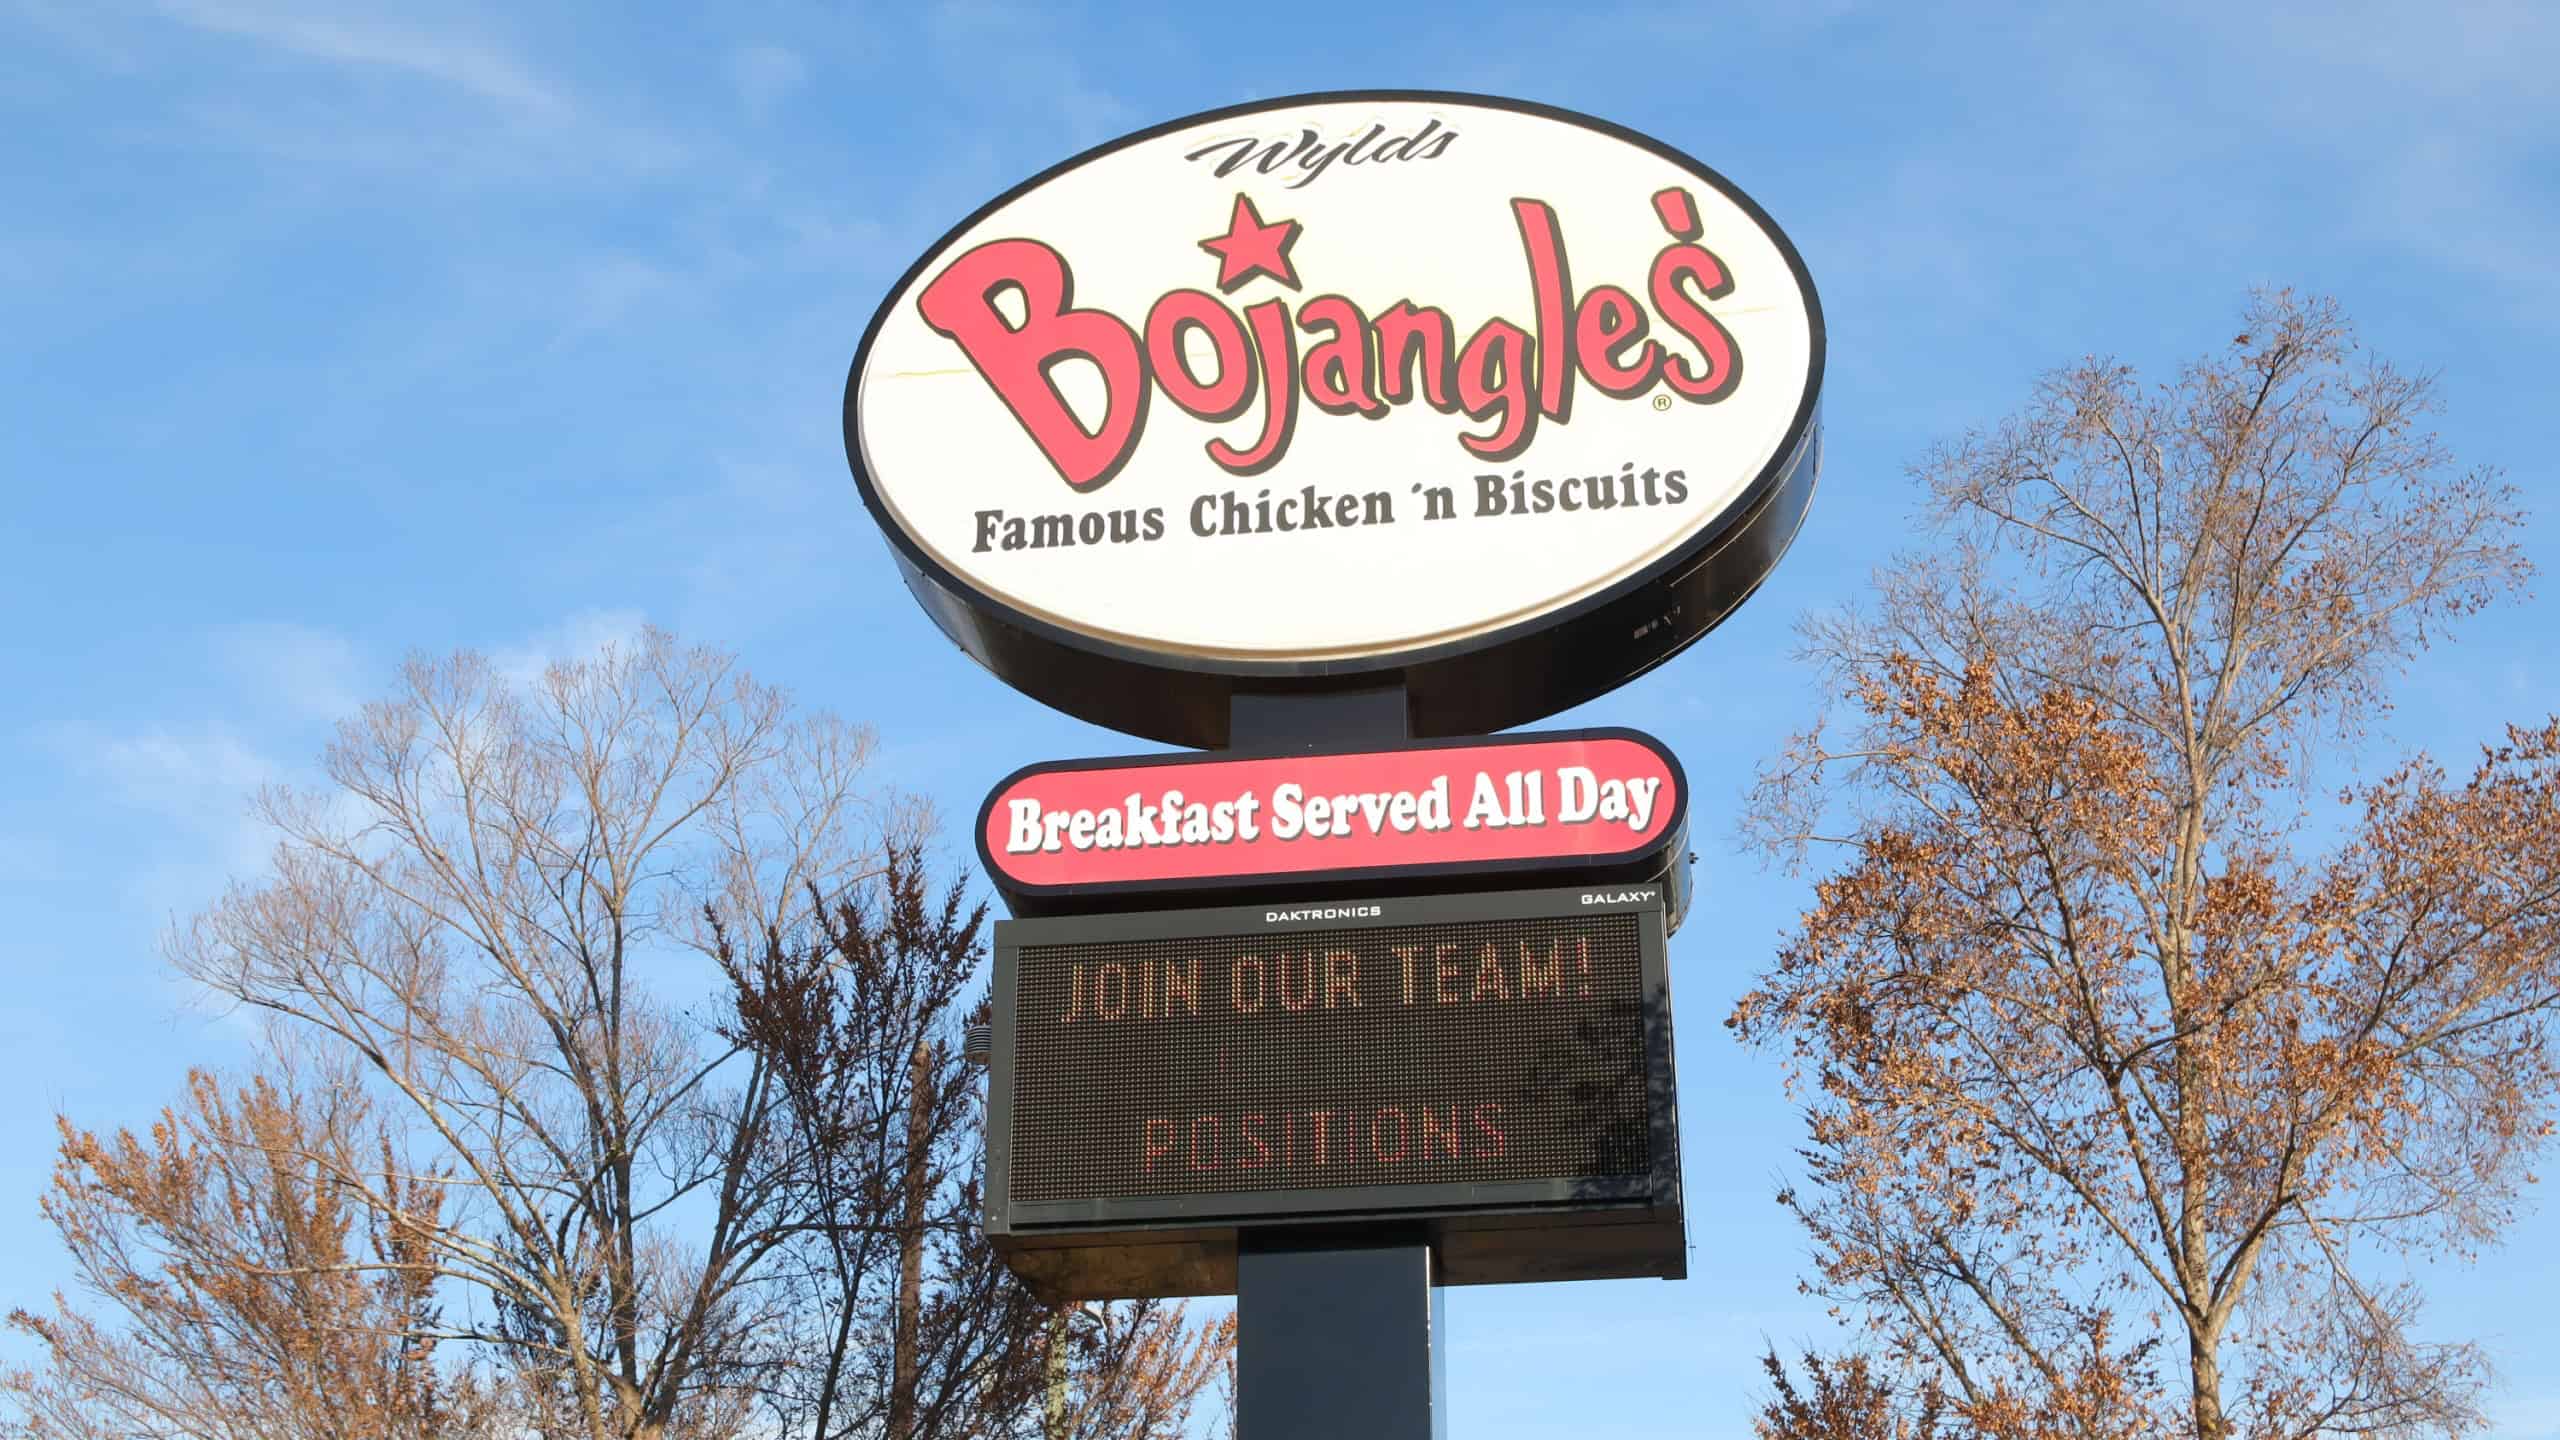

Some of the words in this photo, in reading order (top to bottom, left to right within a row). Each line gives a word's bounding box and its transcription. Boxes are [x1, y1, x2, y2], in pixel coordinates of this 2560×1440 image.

[1184, 118, 1460, 189] Wylds
[917, 187, 1744, 493] Bojangle's
[971, 502, 1165, 554] Famous
[1189, 484, 1395, 539] Chicken
[1474, 461, 1689, 518] Biscuits
[1006, 790, 1260, 856] Breakfast
[1271, 774, 1449, 841] Served
[1463, 769, 1548, 831] All
[1557, 766, 1662, 833] Day
[1266, 906, 1381, 922] DAKTRONICS
[1581, 891, 1655, 904] GALAXY
[1061, 957, 1203, 1024] JOIN
[1231, 949, 1363, 1015] OUR
[1391, 936, 1594, 1006] TEAM!
[1144, 1102, 1506, 1174] POSITIONS
